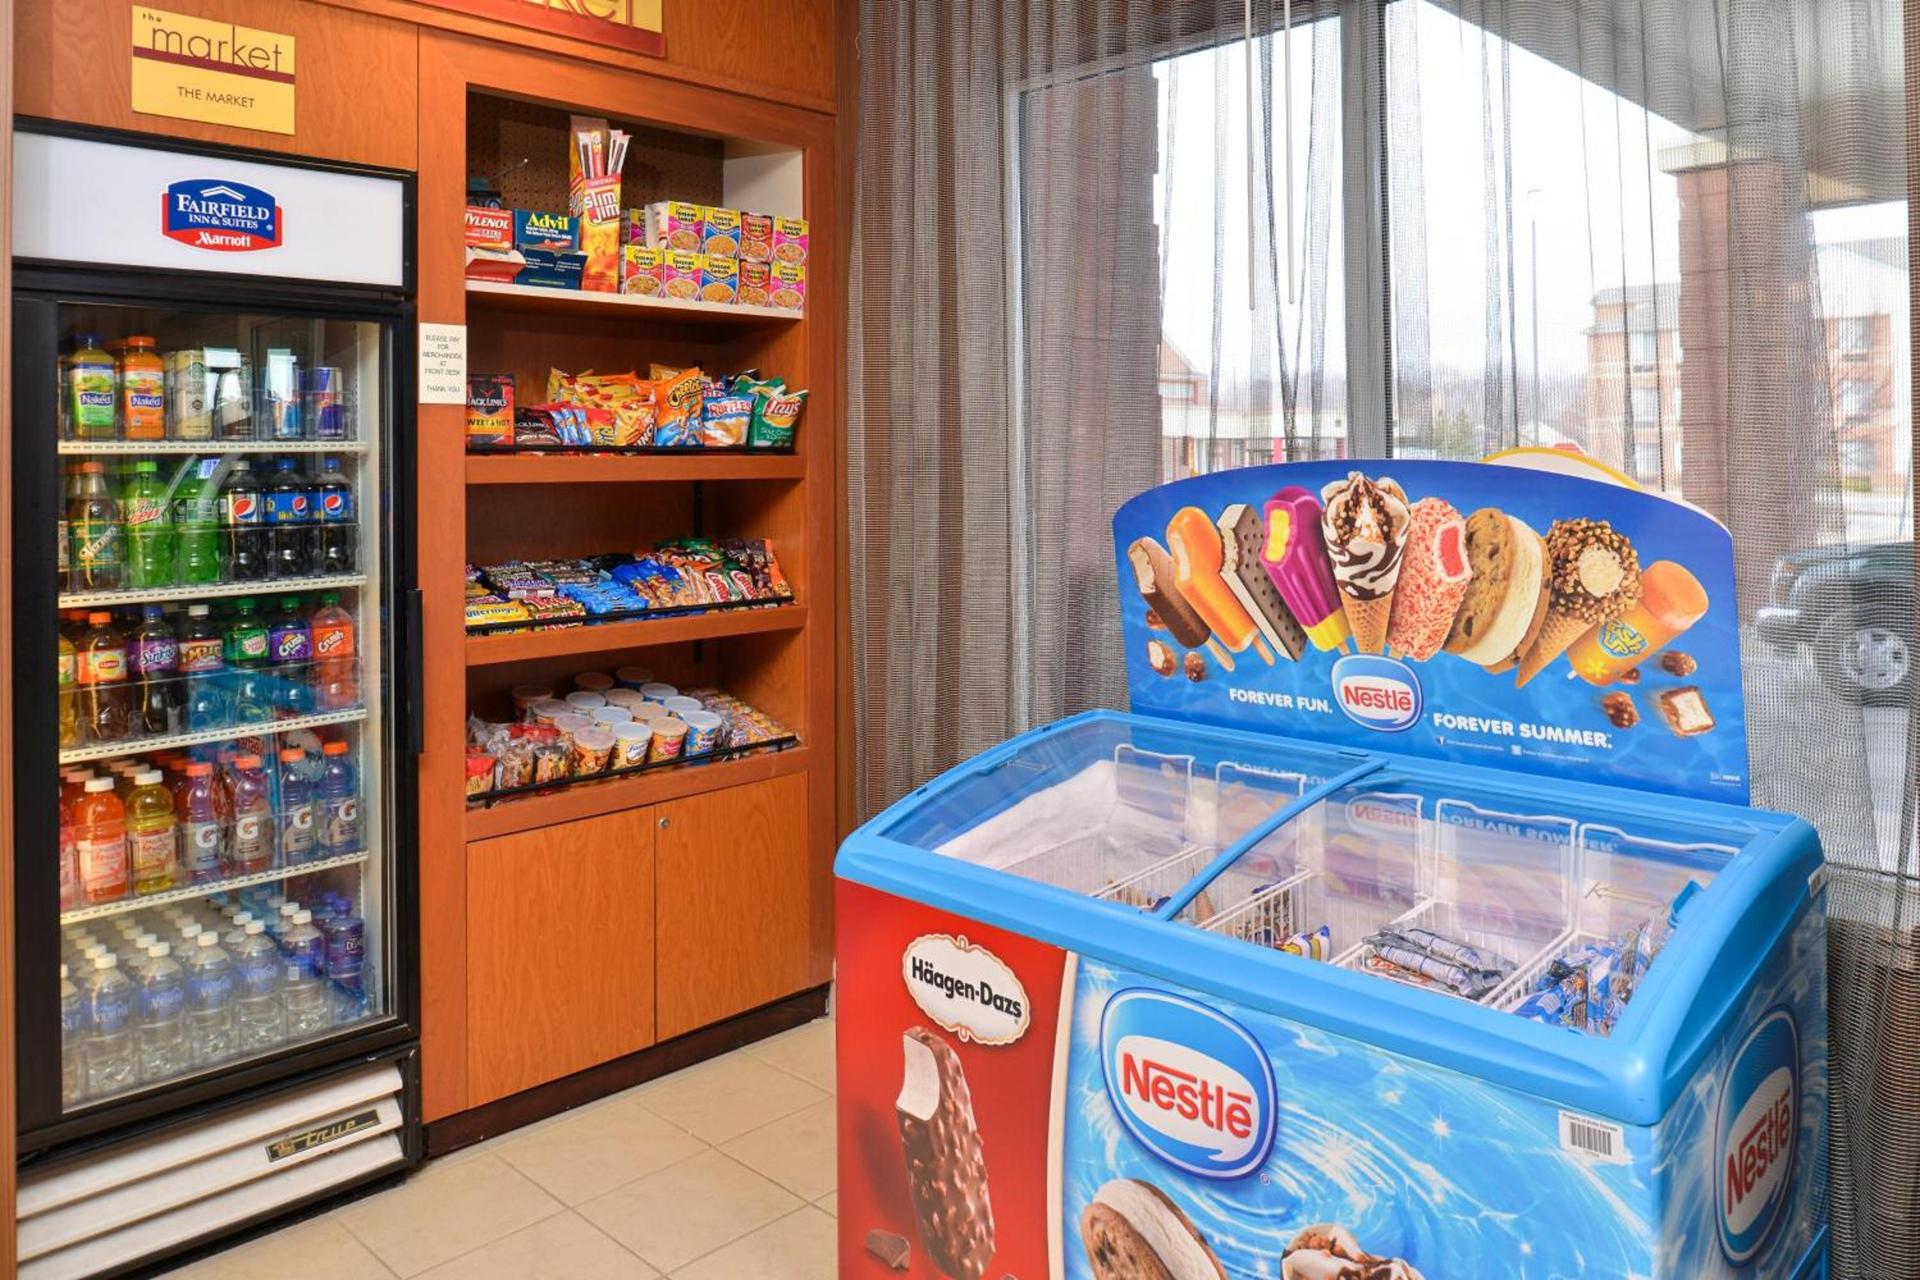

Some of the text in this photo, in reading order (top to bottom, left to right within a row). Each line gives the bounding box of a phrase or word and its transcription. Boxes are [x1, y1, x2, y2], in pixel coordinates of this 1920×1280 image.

[142, 12, 162, 23] the
[152, 25, 283, 72] market
[177, 86, 255, 109] THE MARKET
[176, 193, 270, 221] FAIRFIELD
[188, 214, 259, 230] INN & SUITES
[464, 213, 509, 229] TYLENOL
[527, 212, 569, 231] Advil
[195, 231, 251, 249] Marriott
[426, 384, 446, 392] THANK
[81, 394, 112, 405] Naked
[132, 395, 161, 406] Naked
[467, 398, 486, 407] JACK
[709, 400, 752, 417] RUFFLES
[466, 607, 518, 618] utterfinger
[279, 633, 306, 656] Crush
[318, 630, 344, 653] Crush
[1229, 688, 1333, 714] FOREVER FUN.
[1432, 713, 1515, 737] FOREVER
[1520, 723, 1612, 749] SUMMER.
[195, 824, 218, 847] G
[236, 816, 259, 839] G
[911, 956, 1023, 1019] Häagen-Dazs
